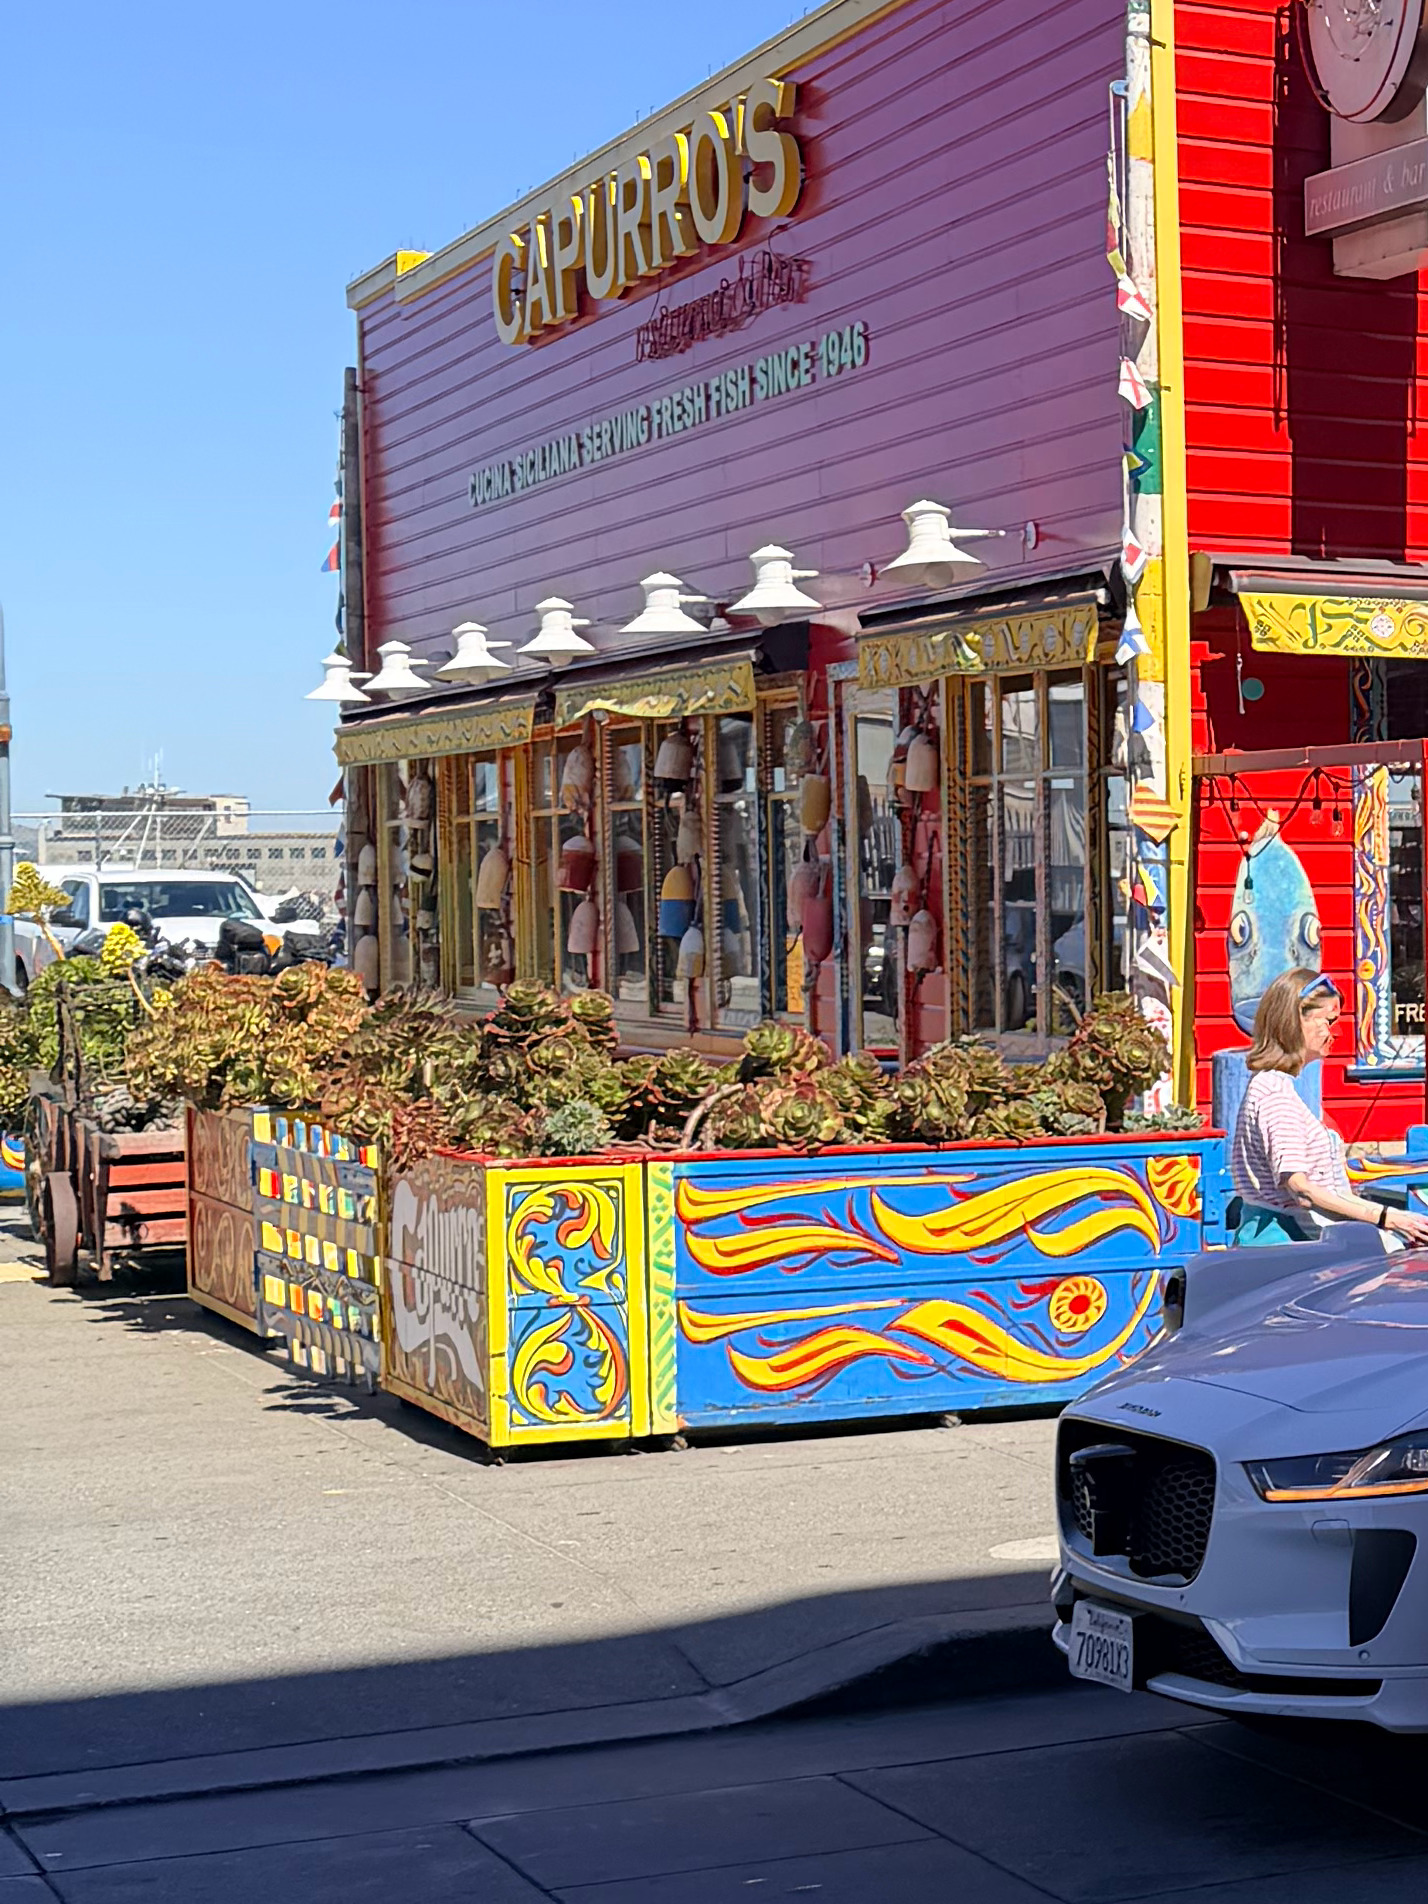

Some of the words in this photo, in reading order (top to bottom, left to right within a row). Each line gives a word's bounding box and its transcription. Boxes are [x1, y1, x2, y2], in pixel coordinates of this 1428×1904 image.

[493, 78, 800, 345] CAPURRO'S
[1401, 159, 1425, 187] bar
[469, 461, 513, 506] CUCINA
[515, 434, 581, 489] SICILIANA
[583, 405, 649, 463] SERVING
[652, 382, 706, 439] FRESH
[710, 365, 751, 418] FISH
[755, 342, 813, 400] SINCE
[819, 321, 867, 377] 1946
